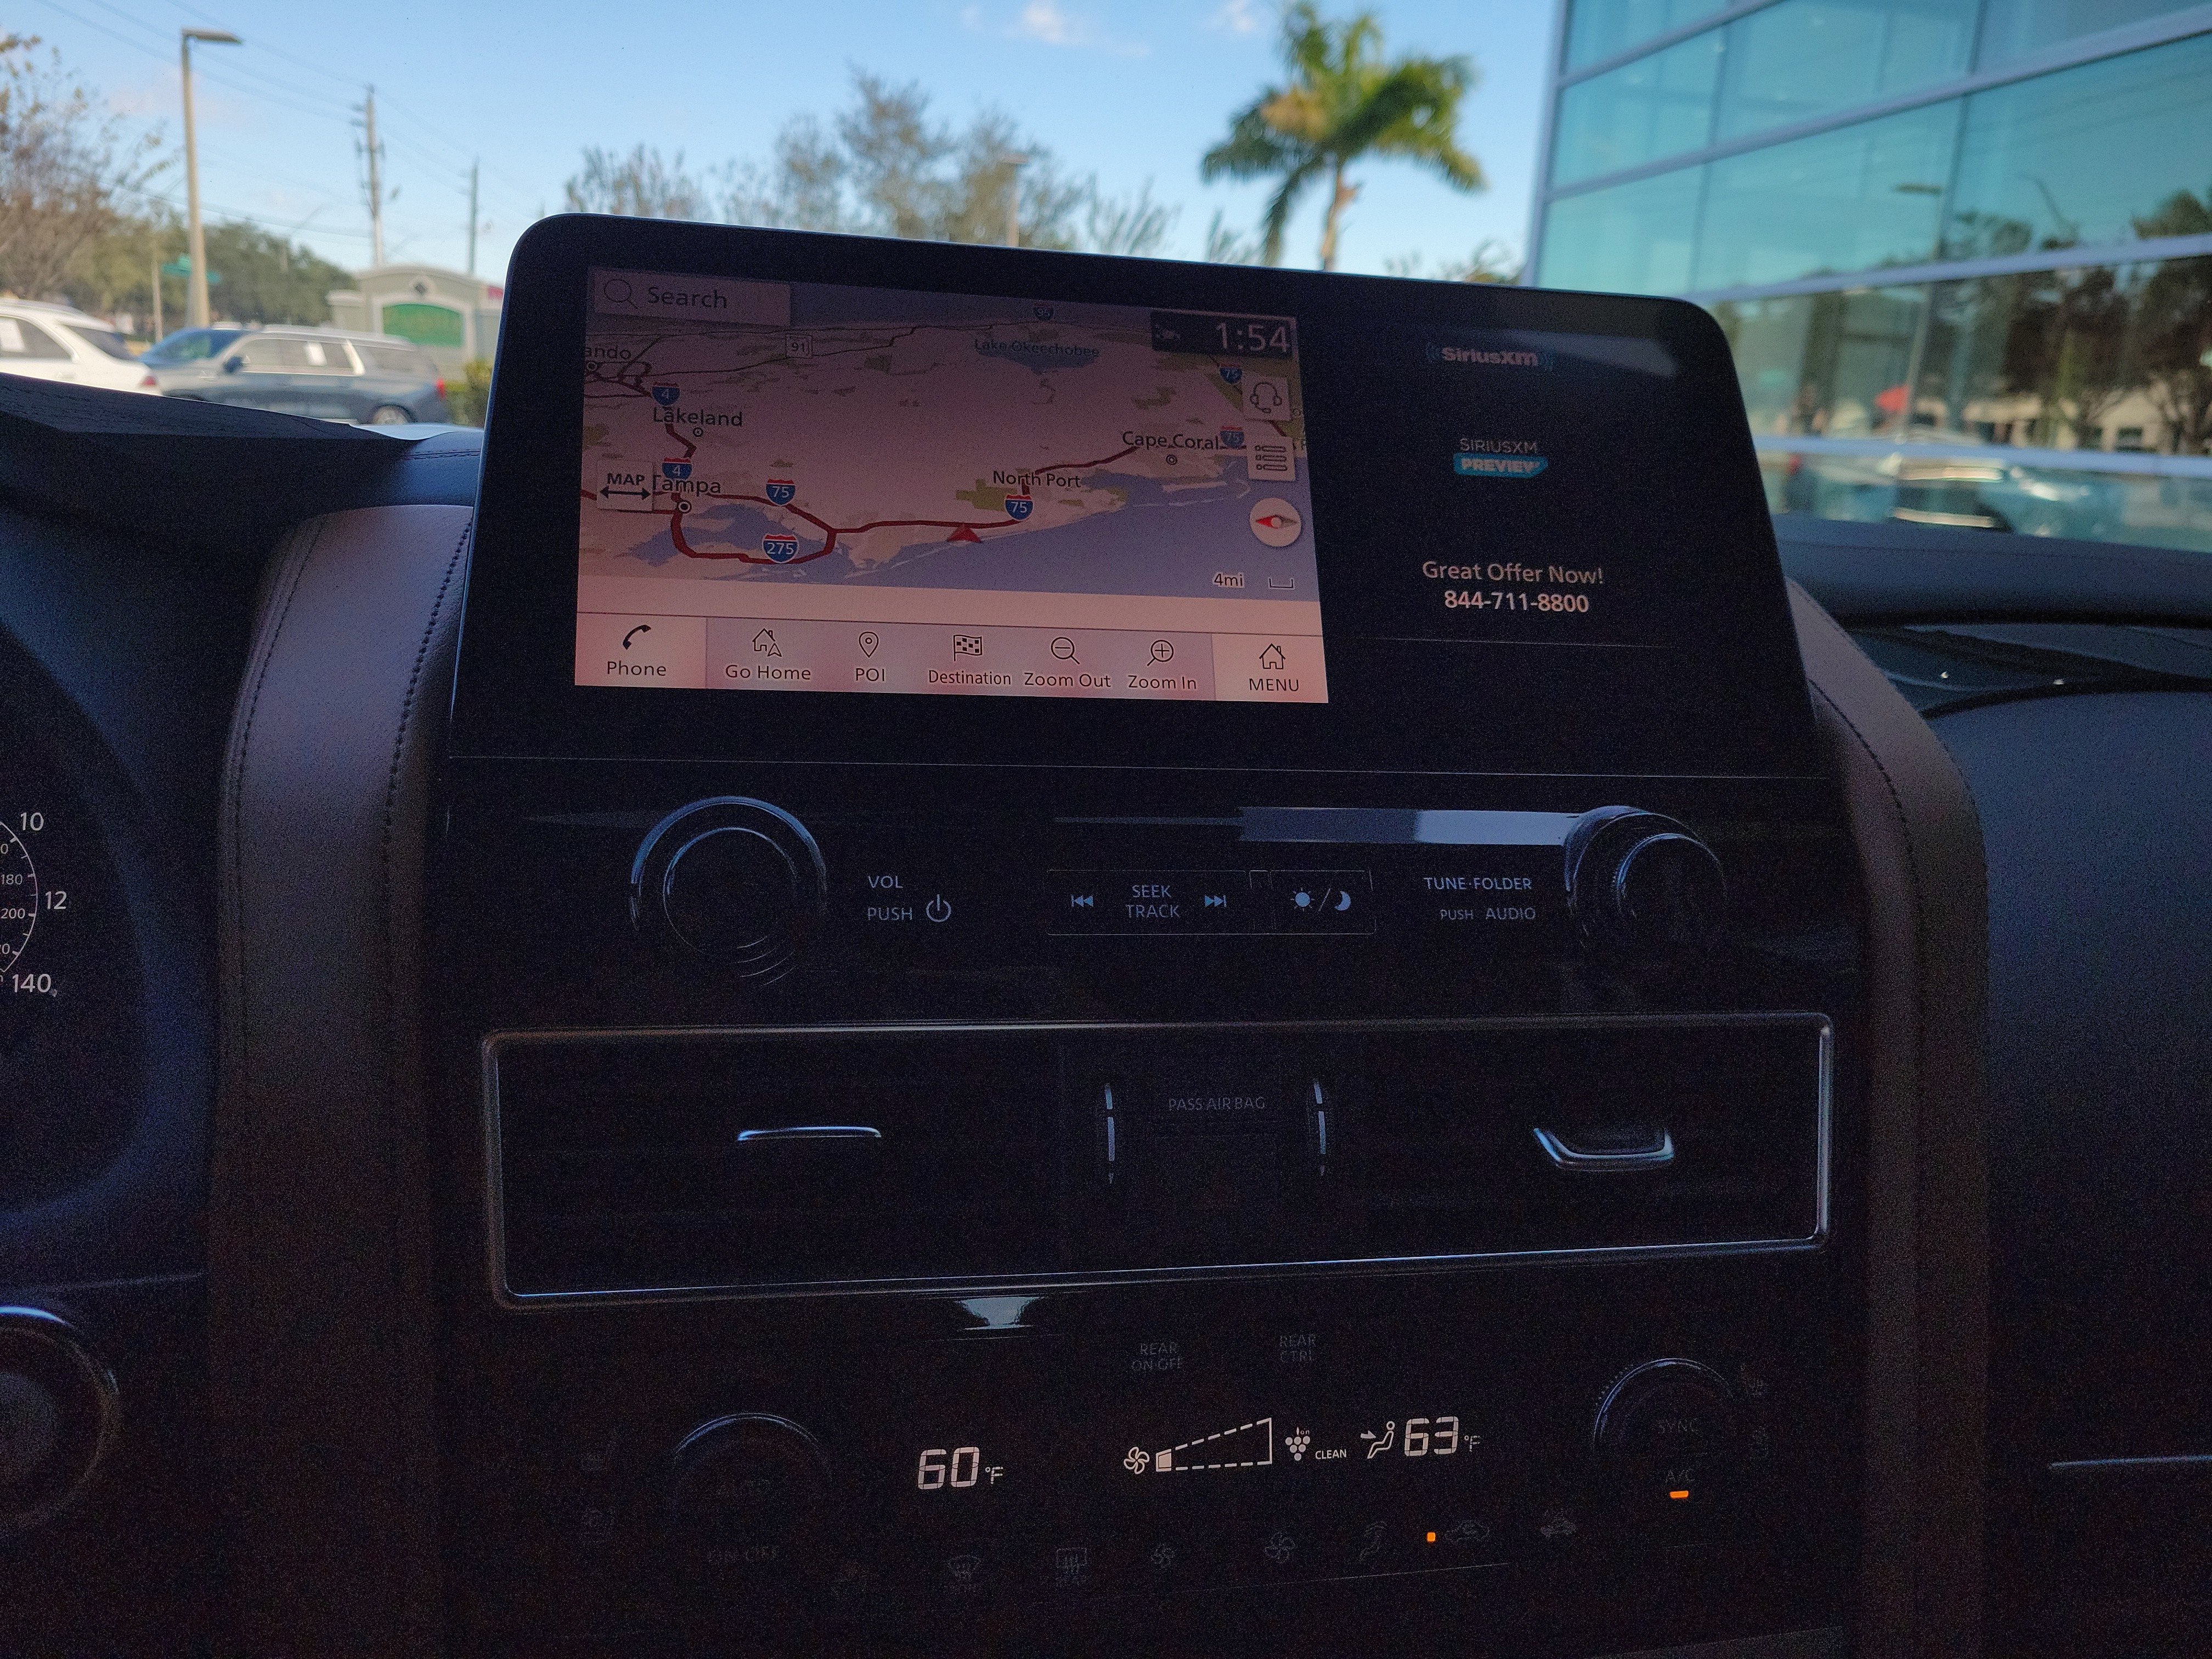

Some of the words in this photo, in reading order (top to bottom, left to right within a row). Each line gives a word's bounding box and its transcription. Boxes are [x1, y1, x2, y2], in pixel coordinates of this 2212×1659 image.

[647, 286, 728, 309] Search
[974, 338, 1007, 352] Lake
[1216, 322, 1289, 353] 1:54
[661, 388, 670, 399] 4
[653, 408, 743, 426] Lakeland
[1121, 431, 1168, 449] Cape
[1172, 433, 1219, 450] Coral
[1460, 438, 1538, 454] SIRIUSXM
[672, 465, 681, 477] 4
[606, 473, 645, 486] MAP
[652, 475, 721, 494] Tampa
[992, 470, 1042, 487] North
[1046, 472, 1081, 488] Port
[772, 485, 790, 498] 75
[1011, 500, 1029, 514] 75
[767, 541, 794, 555] 275
[1213, 572, 1245, 587] 4mi
[1422, 561, 1482, 580] Great
[1487, 563, 1543, 582] Offer
[1548, 566, 1604, 584] Now!
[1444, 590, 1589, 613] 844-711-8800
[606, 661, 667, 676] Phone
[725, 664, 751, 679] Go
[757, 664, 811, 681] Home
[855, 668, 886, 682] POI
[928, 669, 1012, 686] Destination
[1023, 673, 1074, 687] Zoom
[1079, 673, 1111, 689] Out
[1128, 675, 1176, 690] Zoom
[1181, 676, 1197, 690] In
[1249, 678, 1300, 692] MENU
[1, 873, 23, 885] 180
[867, 875, 904, 889] VOL
[1131, 884, 1171, 899] SEEK
[0, 907, 26, 919] 200
[867, 906, 913, 921] PUSH
[1125, 904, 1180, 918] TRACK
[1440, 909, 1474, 921] PUSH
[1485, 906, 1537, 921] AUDIO
[12, 973, 52, 994] 140
[1168, 1097, 1203, 1111] PASS
[1206, 1097, 1232, 1110] AIR
[1234, 1096, 1266, 1109] BAG
[1139, 1341, 1178, 1356] REAR
[1314, 1448, 1347, 1460] CLEAN
